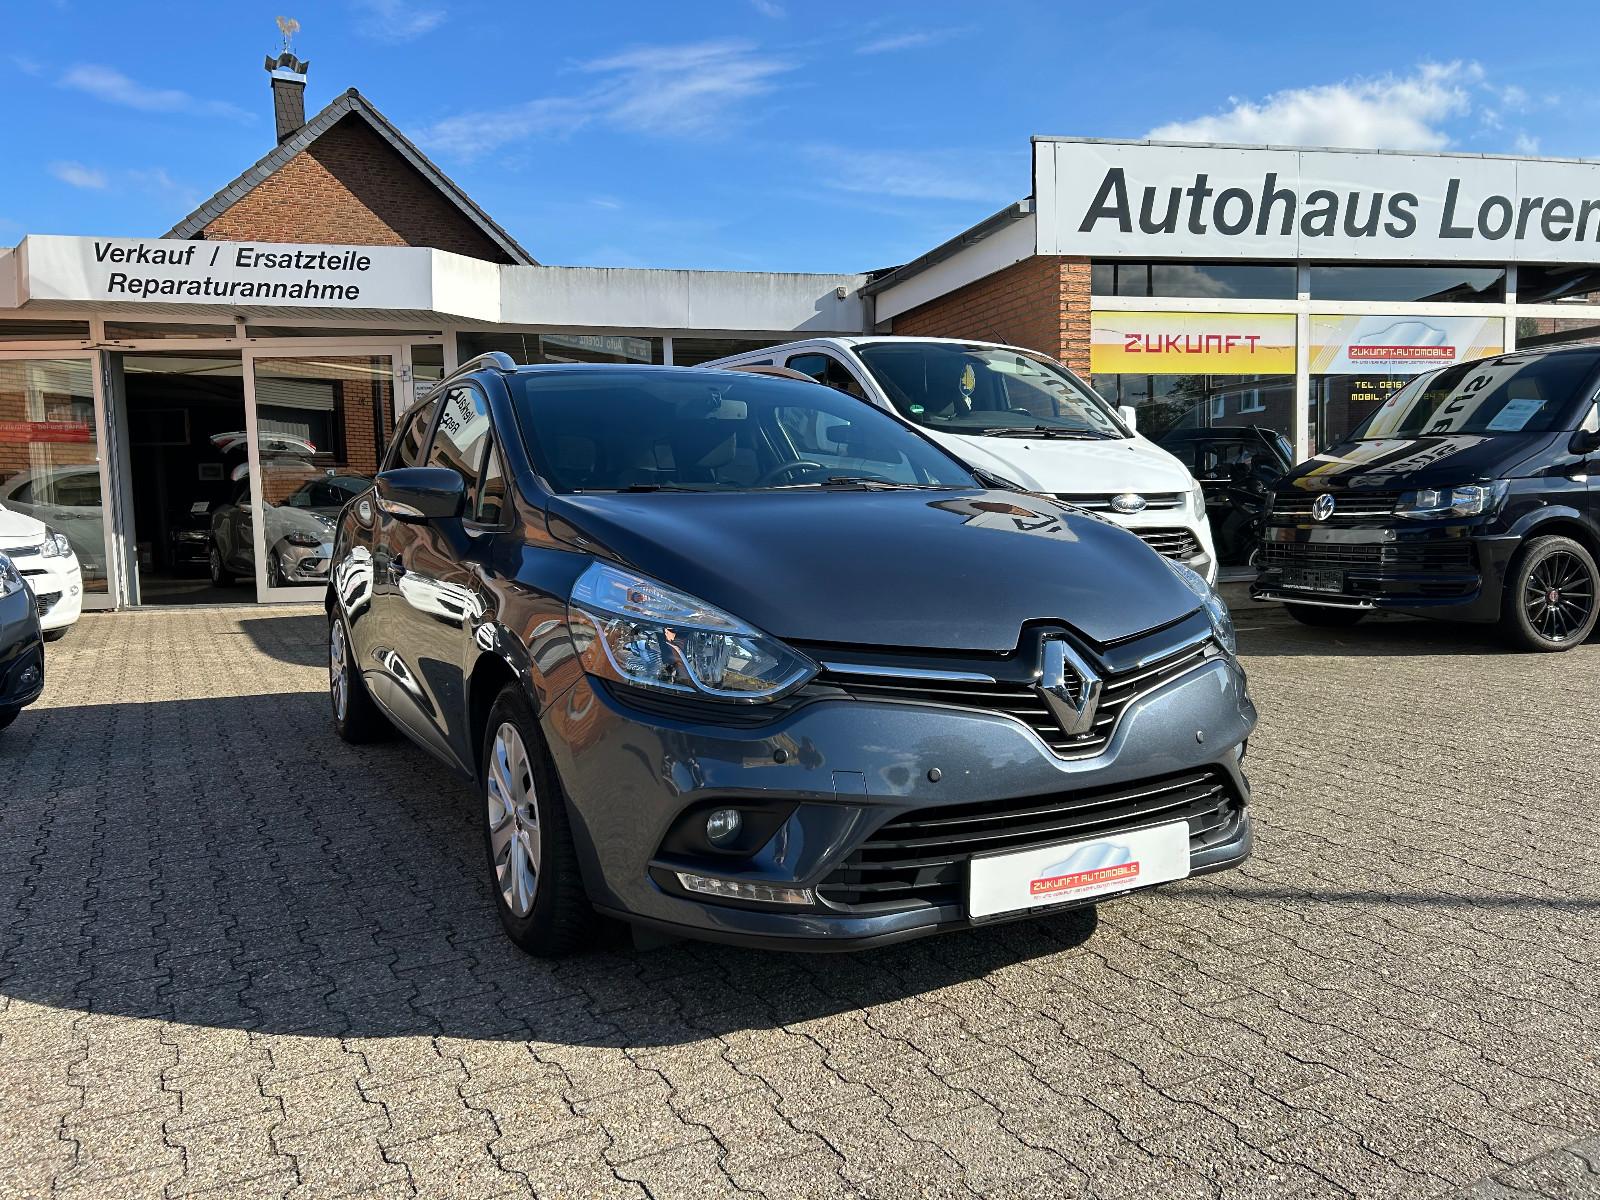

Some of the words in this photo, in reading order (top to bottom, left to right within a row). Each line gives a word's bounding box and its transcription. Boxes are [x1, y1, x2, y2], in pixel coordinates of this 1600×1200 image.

[1078, 168, 1419, 239] Autohaus
[1437, 179, 1600, 242] Loren
[95, 242, 196, 267] Verkauf
[235, 247, 371, 272] Ersatzteile
[107, 272, 360, 300] Reparaturannahme
[1124, 333, 1260, 354] ZUKUNFT
[1351, 348, 1395, 356] ZUKUNFT
[1396, 348, 1453, 357] AUTOMOBILE
[1351, 393, 1382, 401] MOBIL.
[1355, 381, 1376, 389] TEL.
[1033, 876, 1079, 891] ZUKUNFT
[1081, 864, 1137, 882] AUTOMOBILE
